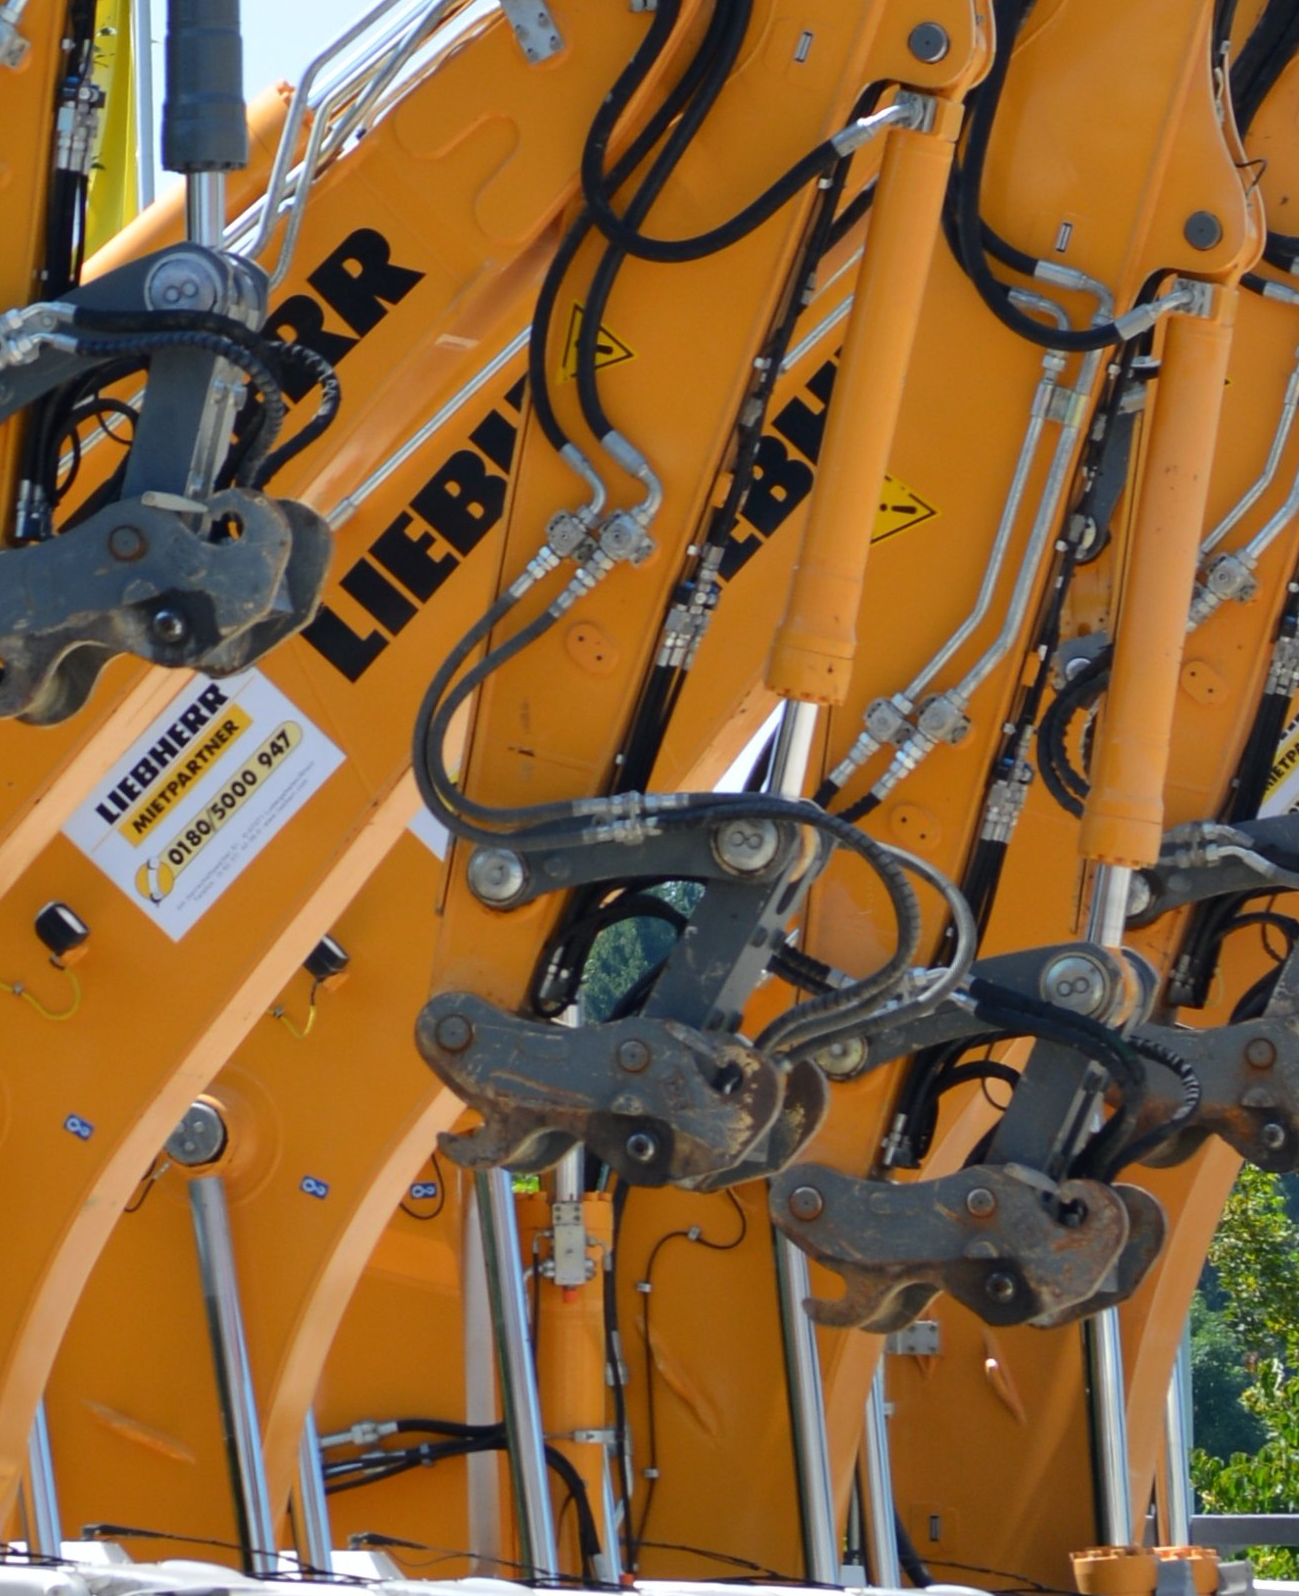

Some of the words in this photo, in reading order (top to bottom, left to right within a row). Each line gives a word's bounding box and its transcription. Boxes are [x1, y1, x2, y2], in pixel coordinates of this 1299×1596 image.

[300, 372, 529, 683] LIEB
[95, 683, 228, 825] LIEBHERR
[132, 719, 239, 834] MIETPARTNER
[168, 769, 258, 865] 0180/5000
[257, 729, 291, 769] 947
